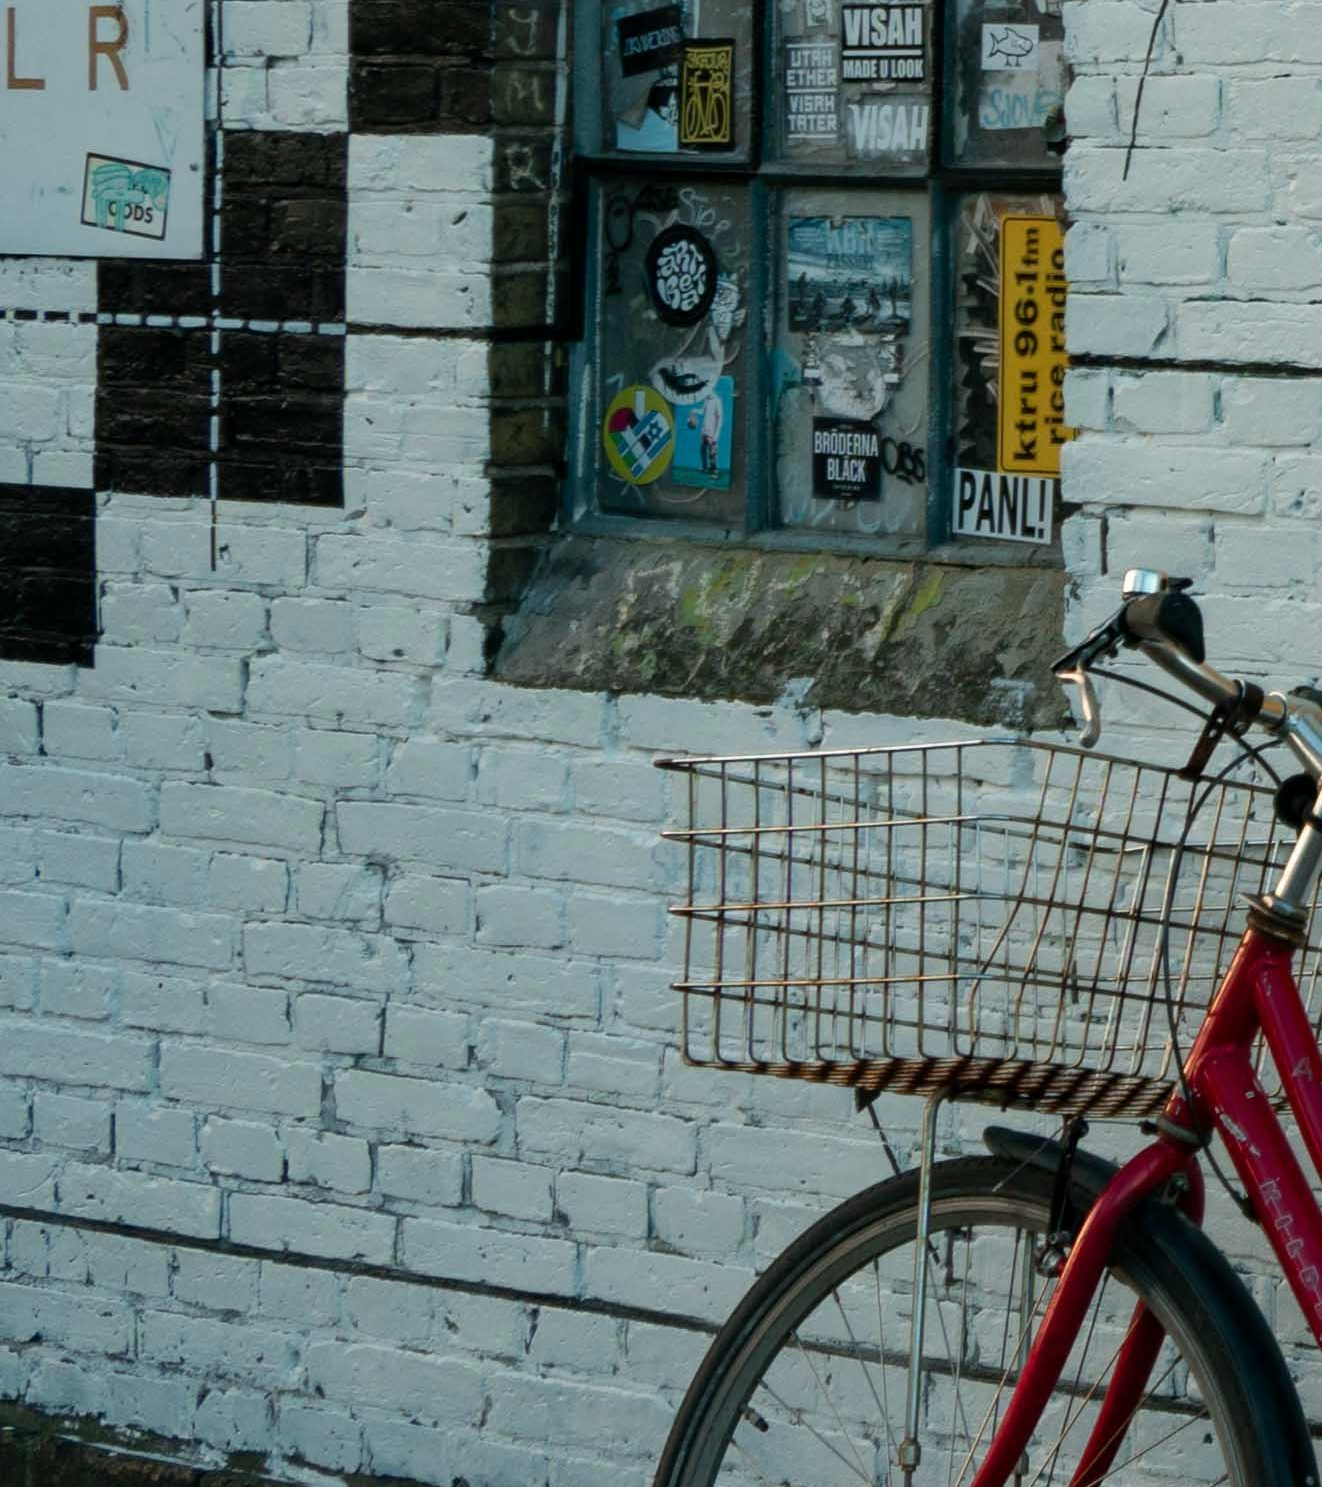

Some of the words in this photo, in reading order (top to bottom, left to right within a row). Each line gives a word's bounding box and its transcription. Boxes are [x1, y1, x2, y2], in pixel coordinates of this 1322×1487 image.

[842, 7, 923, 47] VISAH
[843, 58, 879, 79] MADE
[880, 58, 889, 78] U
[890, 58, 924, 79] LOOK
[849, 104, 930, 151] VISAH
[1013, 369, 1038, 462] ktru
[958, 469, 1047, 540] PANL!
